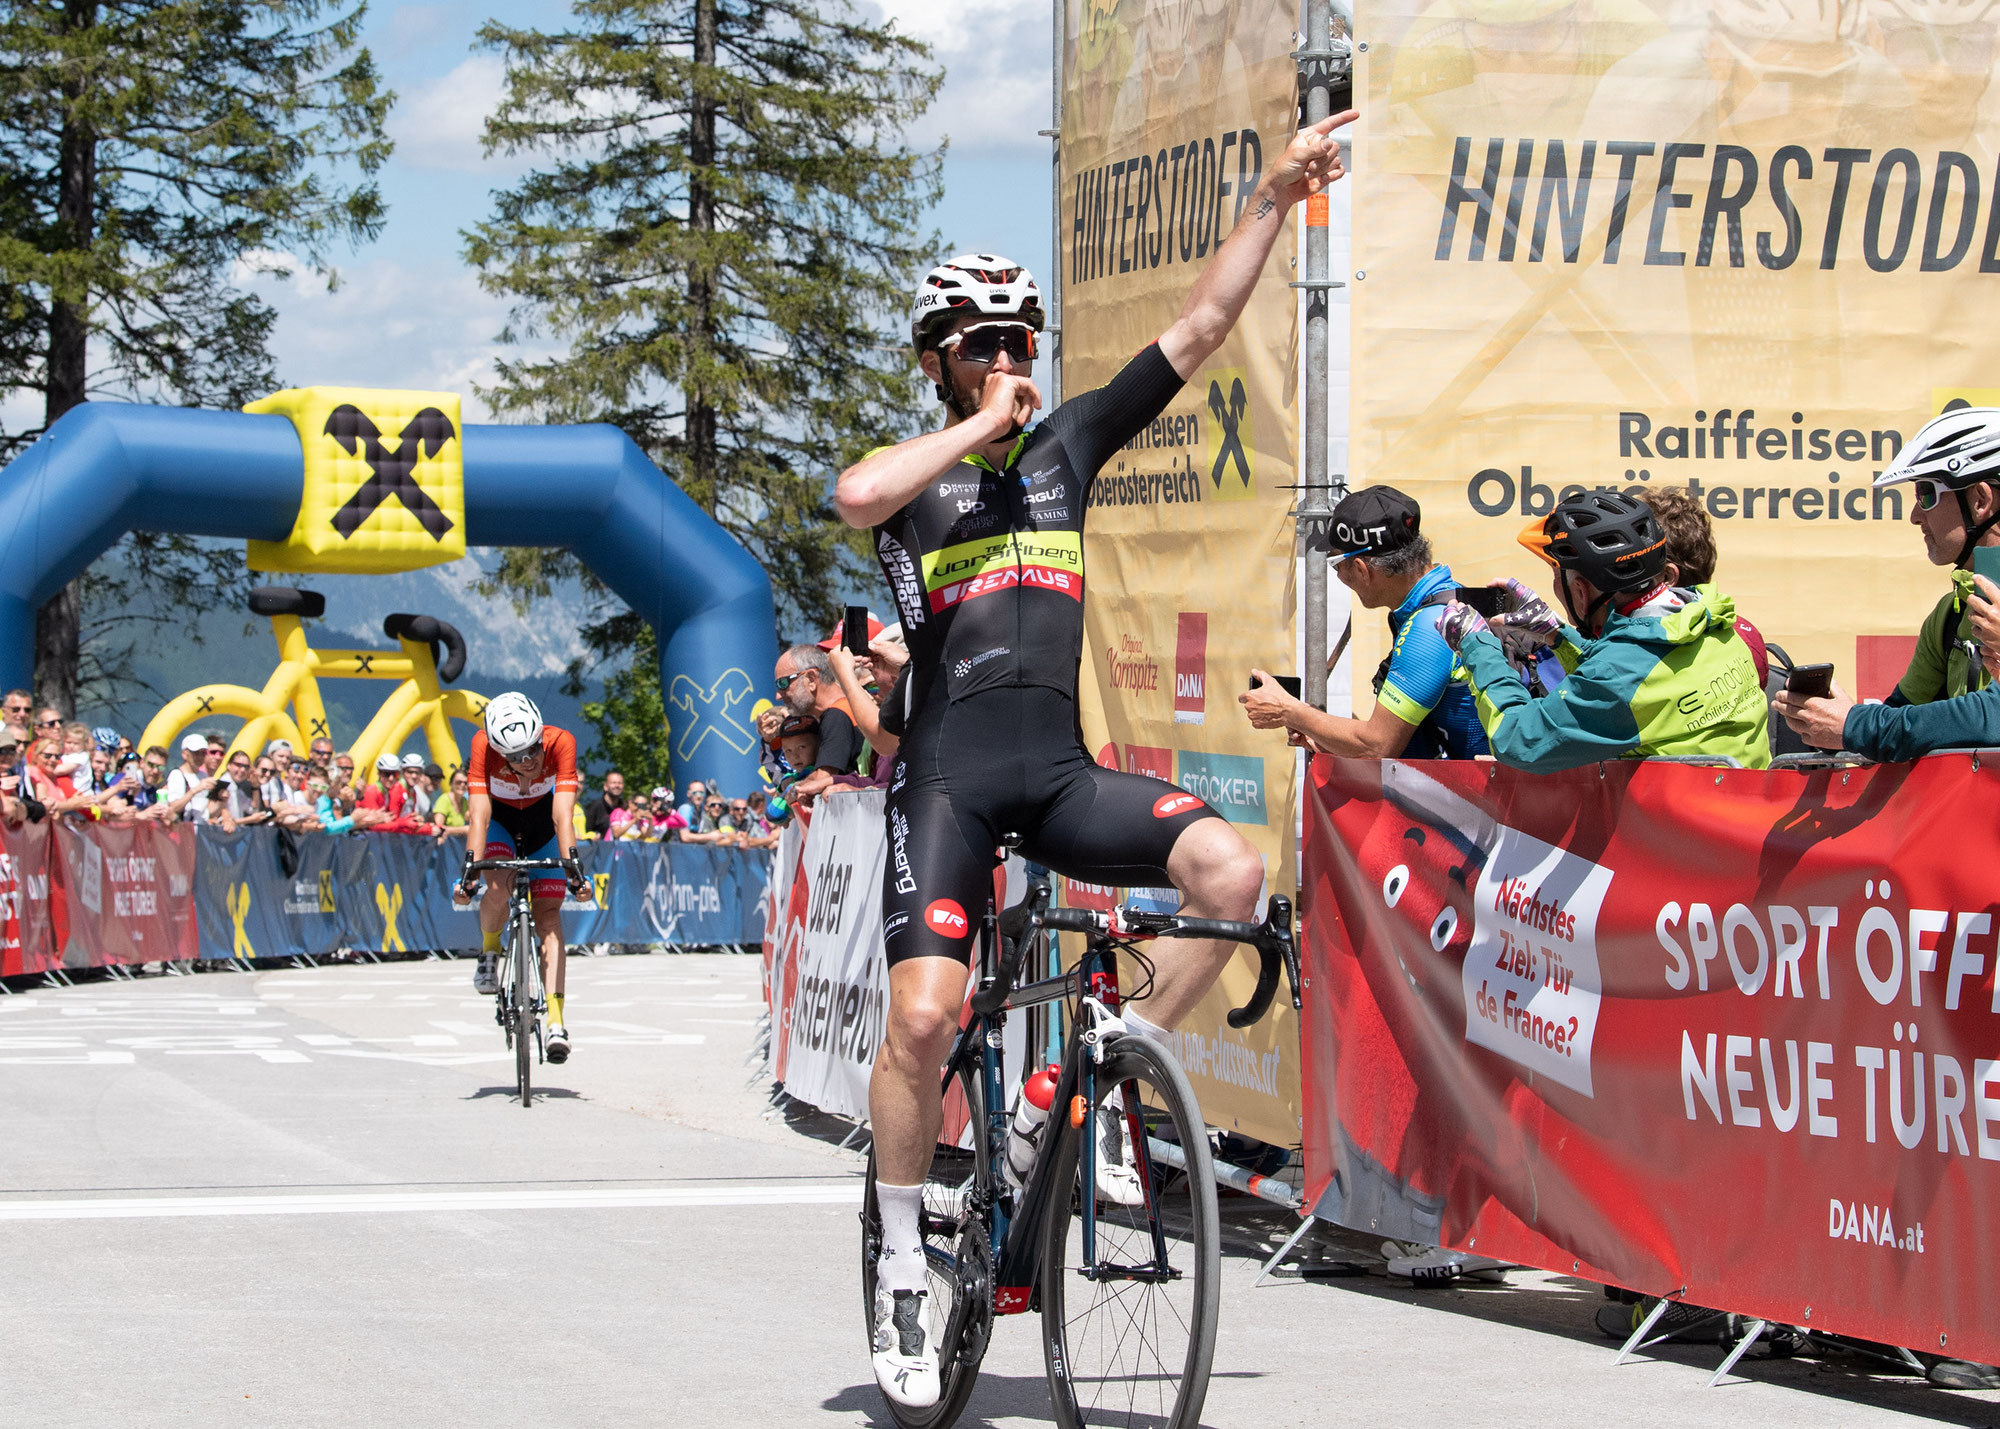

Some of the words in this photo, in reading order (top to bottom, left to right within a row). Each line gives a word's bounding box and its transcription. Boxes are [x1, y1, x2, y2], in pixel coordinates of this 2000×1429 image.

[1072, 128, 1262, 285] HINTERSTODER
[915, 294, 938, 310] uvex
[1121, 413, 1198, 450] feisen
[1619, 409, 1902, 462] Raiffeisen
[956, 499, 985, 514] tip
[1023, 488, 1056, 505] AGU
[1029, 509, 1067, 521] SAMINA
[1467, 465, 1902, 520] Oböterreich
[1336, 522, 1387, 546] OUT
[1615, 546, 1652, 563] FACTORY
[880, 552, 917, 630] PROFILE
[892, 549, 926, 623] DESIGN
[960, 568, 1070, 598] REMUS
[1106, 646, 1159, 698] Kornspitz
[1177, 673, 1203, 698] DANA
[1183, 767, 1259, 806] STÖCKER
[891, 806, 917, 894] orarlberg
[809, 835, 852, 935] ober
[1494, 873, 1576, 943] Nächstes
[1495, 929, 1537, 982] Ziel:
[1541, 946, 1574, 996] Tür
[1655, 901, 1838, 1000] SPORT
[1476, 979, 1498, 1023] de
[1503, 989, 1579, 1058] France?
[1166, 1026, 1280, 1098] ww.oe-classics.at
[1680, 1029, 1838, 1138] NEUE
[1829, 1199, 1925, 1254] DANA.at
[1412, 1264, 1463, 1279] GIRO
